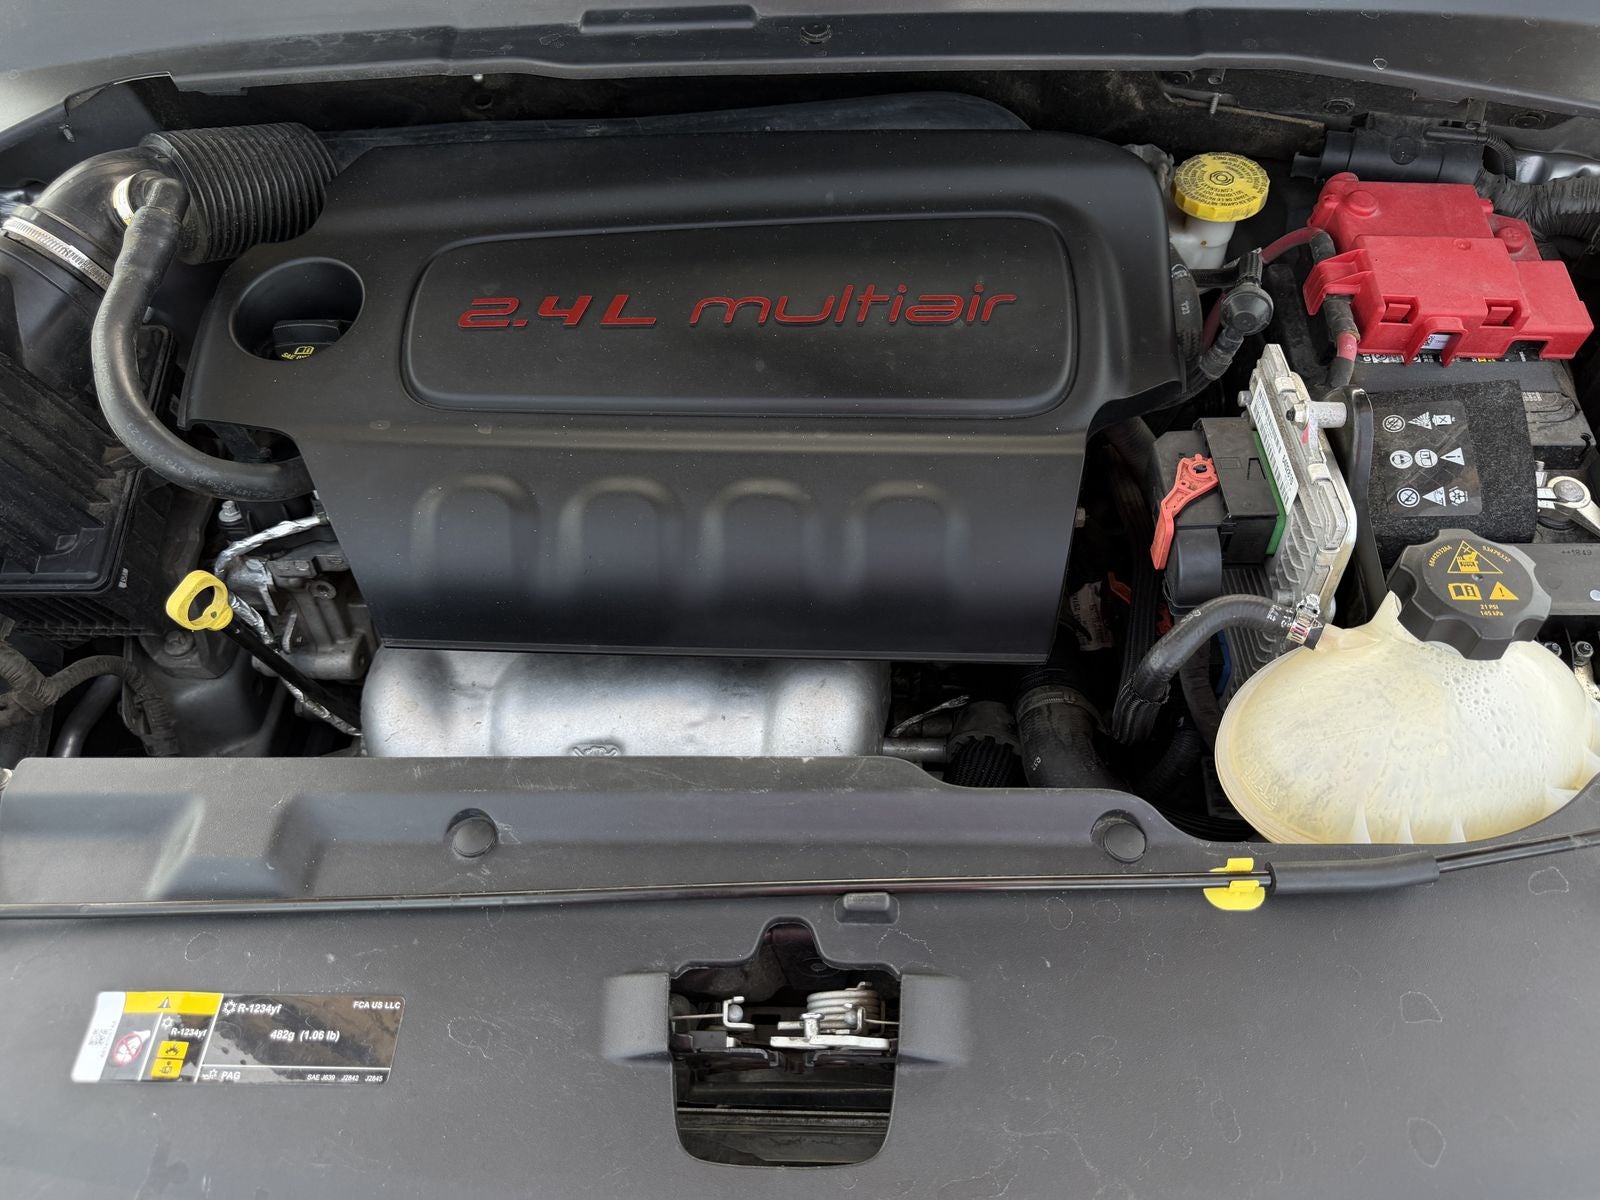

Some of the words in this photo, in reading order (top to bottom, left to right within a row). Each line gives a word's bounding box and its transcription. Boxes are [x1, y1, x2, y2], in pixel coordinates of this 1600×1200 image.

[689, 284, 1017, 324] multiair
[237, 1003, 282, 1016] R-1234yf
[353, 1001, 370, 1009] FCA
[171, 1028, 207, 1038] R-1234yf
[270, 1029, 295, 1042] 482g
[300, 1030, 324, 1042] (1.06
[326, 1030, 340, 1043] lb)
[221, 1071, 241, 1080] PAG
